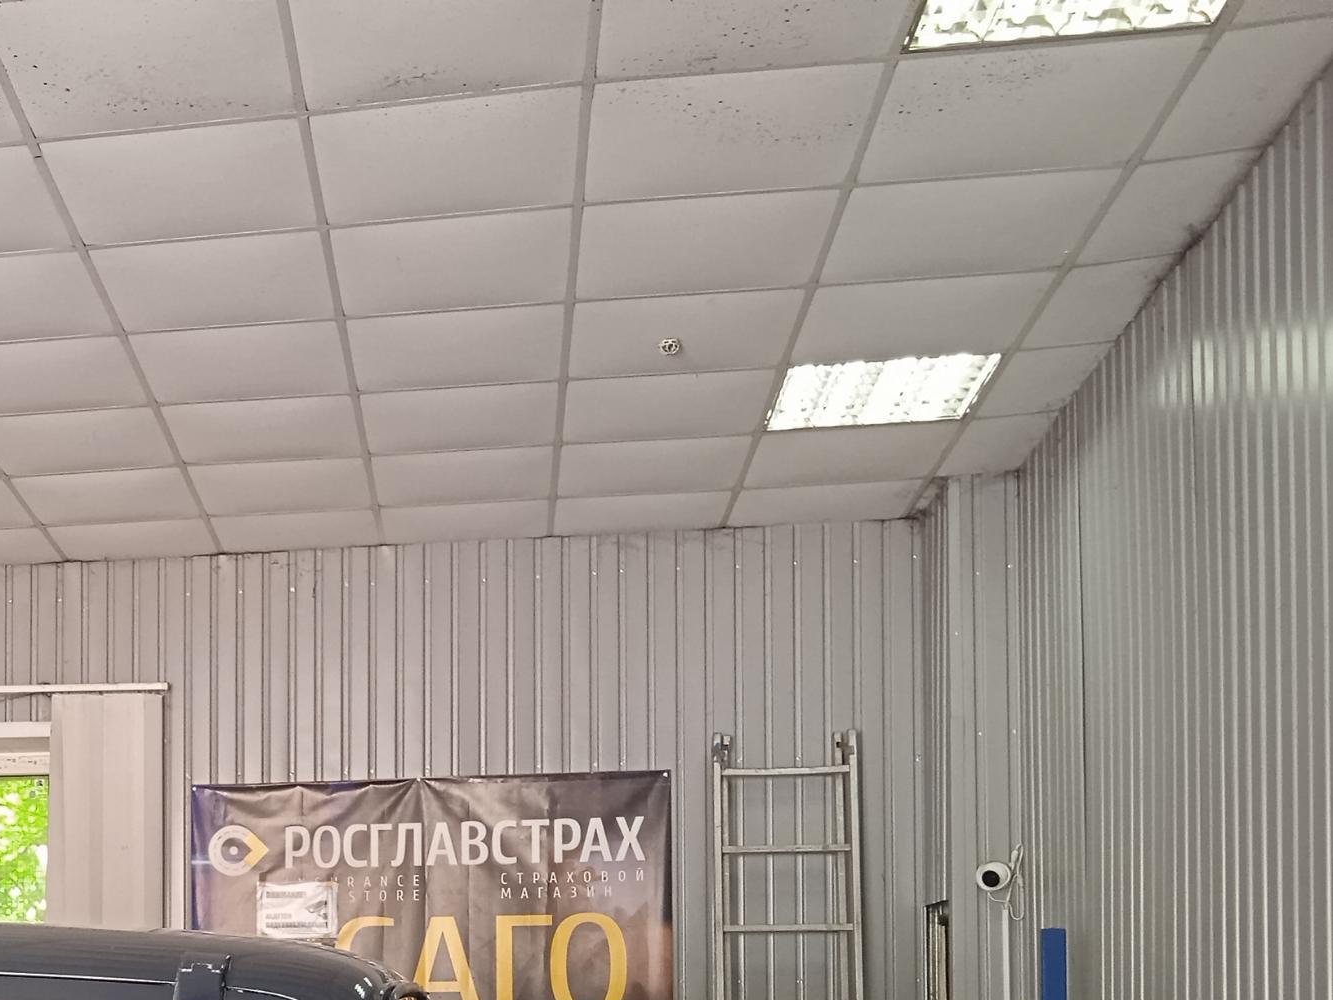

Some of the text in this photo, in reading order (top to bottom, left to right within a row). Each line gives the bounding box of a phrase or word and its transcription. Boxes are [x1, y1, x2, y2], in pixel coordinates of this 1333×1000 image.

[284, 816, 646, 869] РОСГЛАВСТРАХ
[500, 868, 644, 885] СТРАХОВОЙ
[349, 889, 420, 901] STORE
[500, 886, 612, 899] МАГАЗИН
